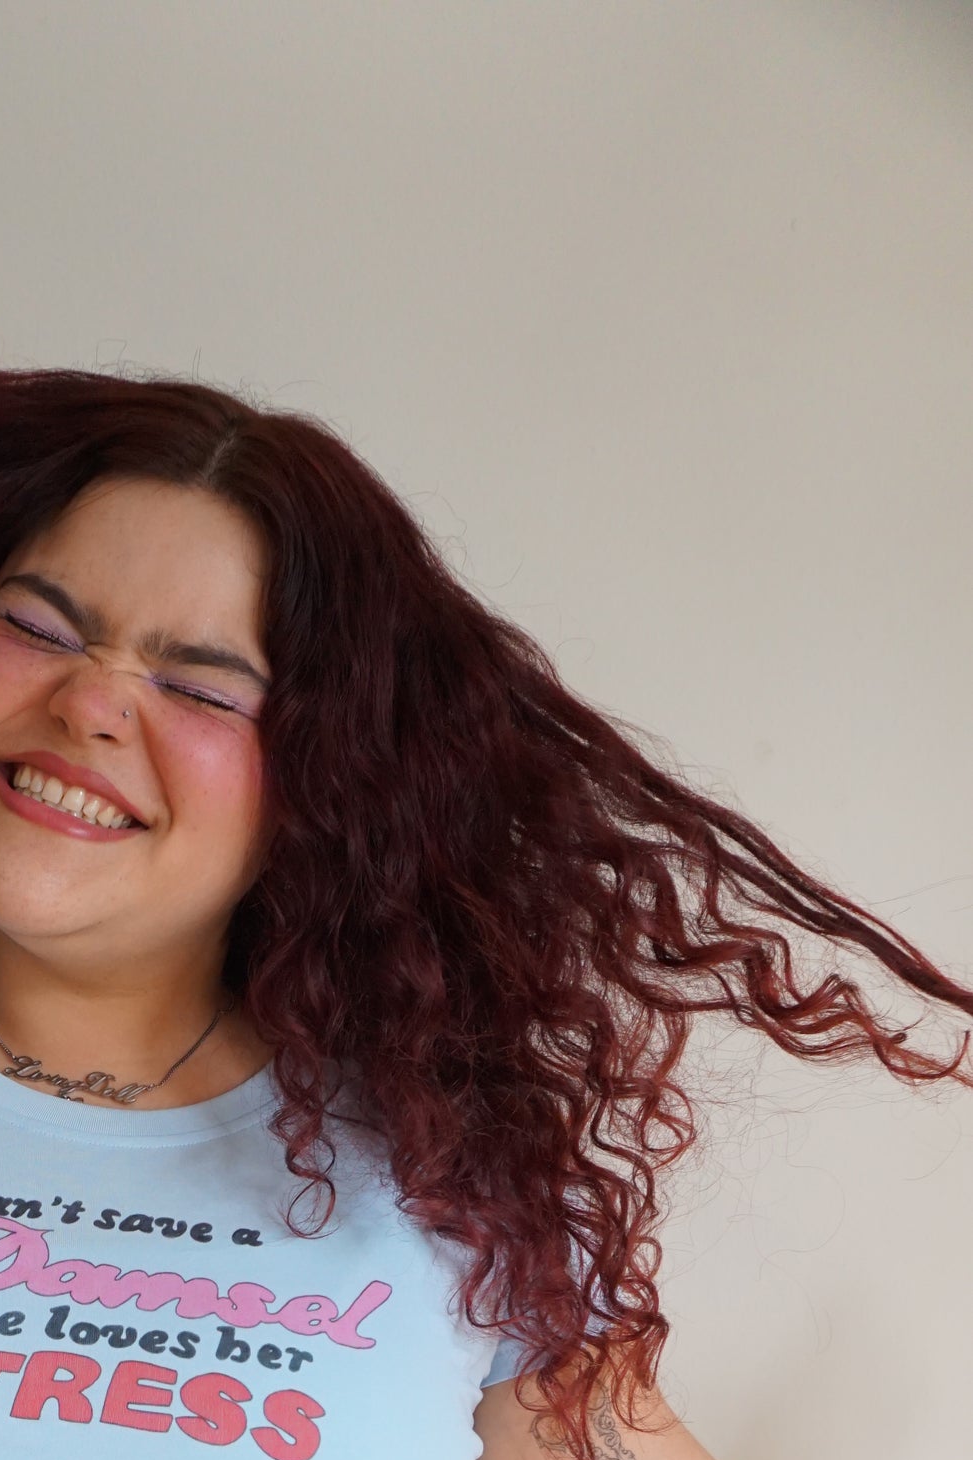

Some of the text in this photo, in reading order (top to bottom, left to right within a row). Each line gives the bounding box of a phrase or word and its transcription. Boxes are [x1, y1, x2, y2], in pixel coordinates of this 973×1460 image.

[93, 1207, 213, 1244] save
[231, 1225, 263, 1248] a
[44, 1305, 201, 1359] loves
[215, 1326, 314, 1373] her
